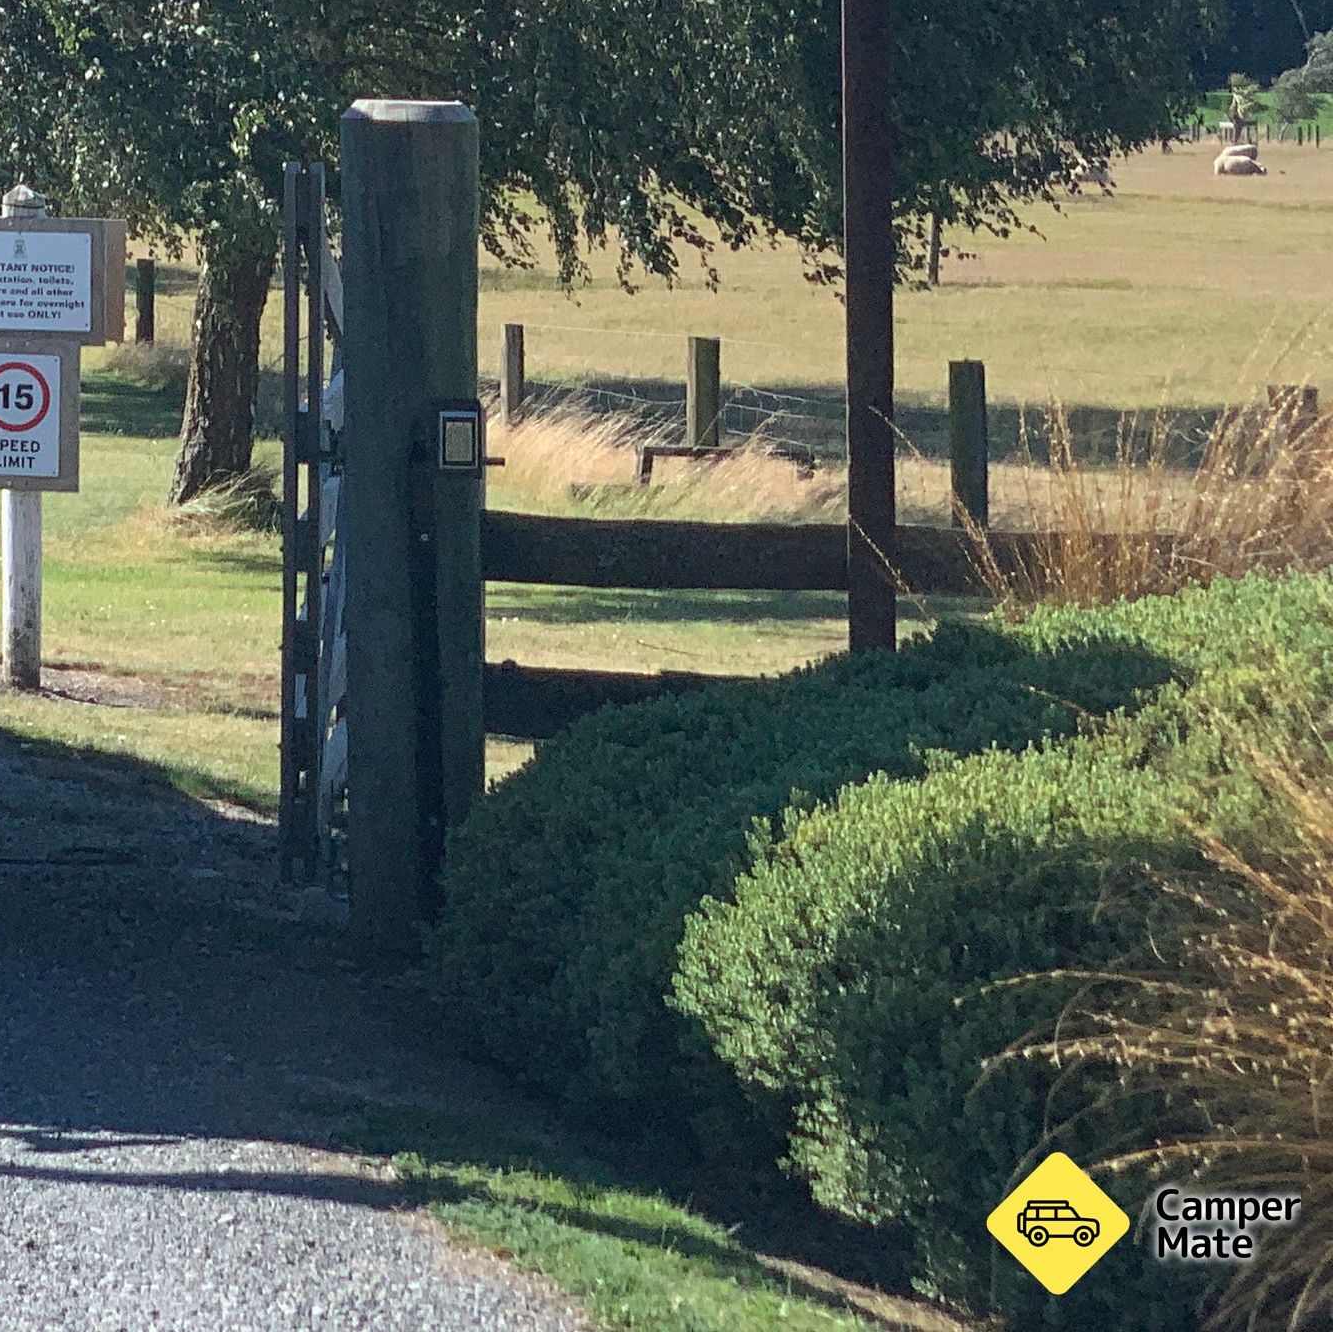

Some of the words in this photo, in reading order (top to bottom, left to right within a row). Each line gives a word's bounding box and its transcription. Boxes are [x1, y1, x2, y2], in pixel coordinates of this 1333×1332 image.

[31, 263, 75, 273] NOTICE!
[10, 287, 28, 295] and
[31, 288, 44, 296] all
[46, 288, 73, 296] other
[0, 299, 16, 307] are
[19, 299, 34, 307] for
[37, 300, 85, 310] overnight
[7, 311, 25, 319] use
[27, 310, 62, 319] ONLY!
